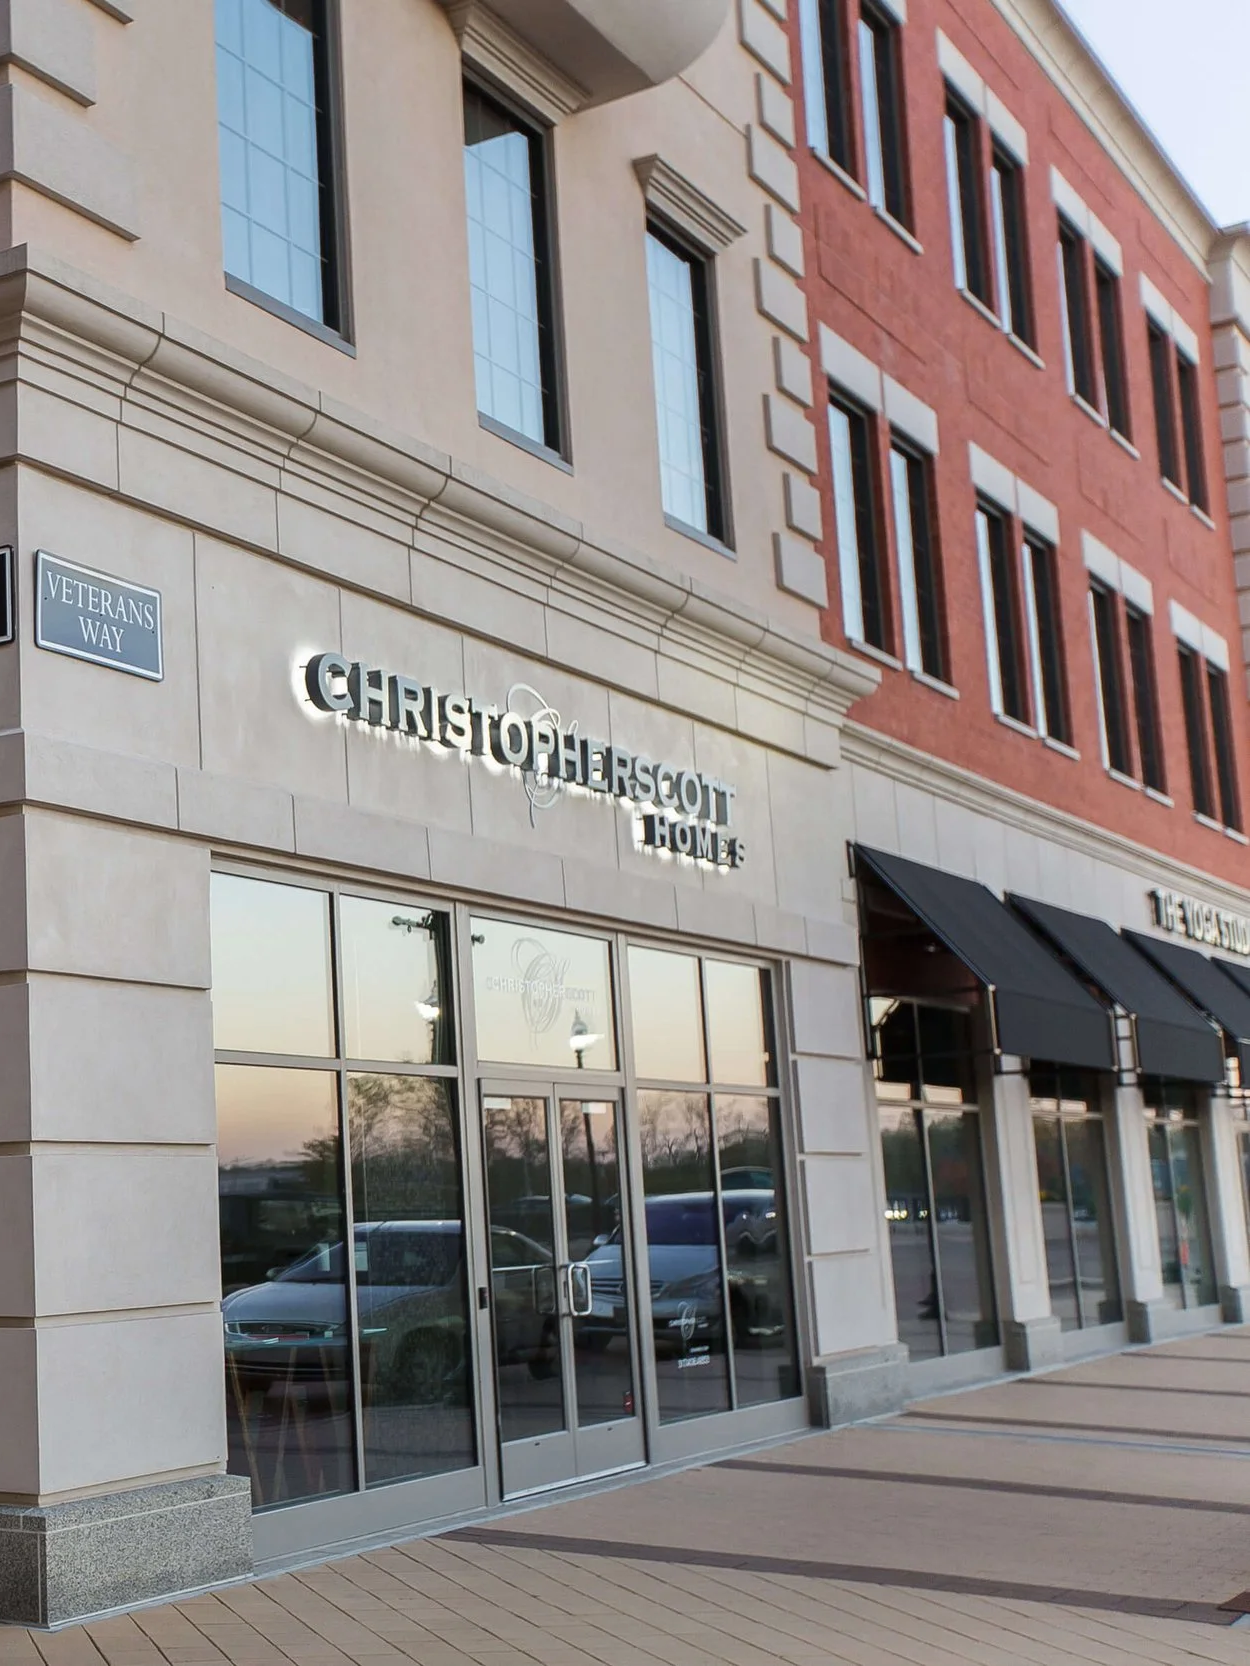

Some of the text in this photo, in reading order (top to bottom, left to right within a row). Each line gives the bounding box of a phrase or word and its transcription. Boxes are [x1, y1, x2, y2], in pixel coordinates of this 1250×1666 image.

[46, 570, 155, 630] VETERANS
[78, 615, 126, 653] WAY
[642, 814, 745, 869] HOMES
